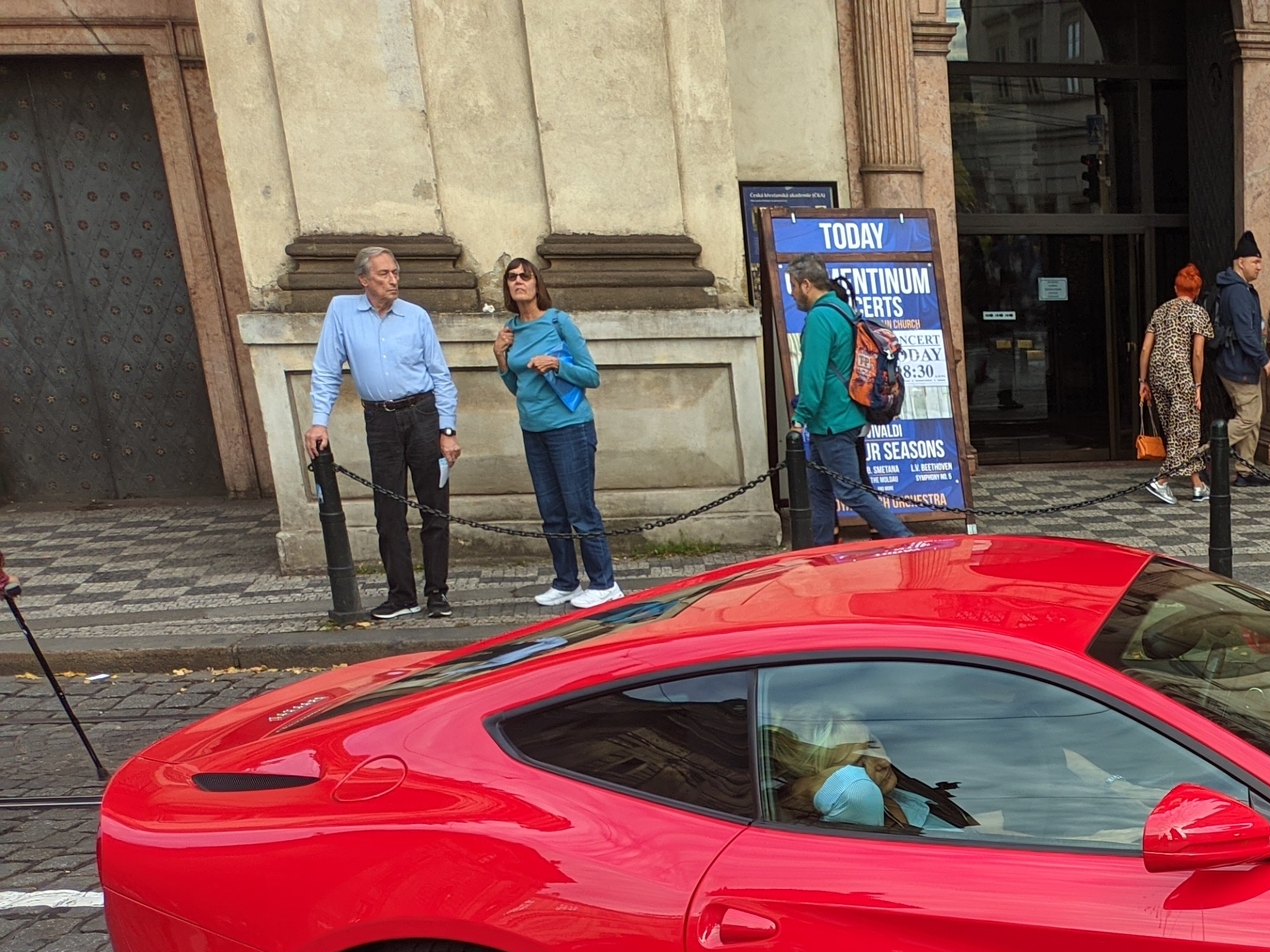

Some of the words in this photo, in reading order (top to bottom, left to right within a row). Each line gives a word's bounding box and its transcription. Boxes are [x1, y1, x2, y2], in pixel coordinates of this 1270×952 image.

[818, 222, 884, 250] TODAY
[892, 319, 921, 330] CHURCH
[899, 335, 940, 345] NCERT
[903, 365, 934, 379] 8:30
[883, 440, 945, 461] SEASONS
[874, 464, 900, 474] SMETANA
[910, 464, 921, 473] L.V.
[921, 462, 953, 472] BEETHOVEN
